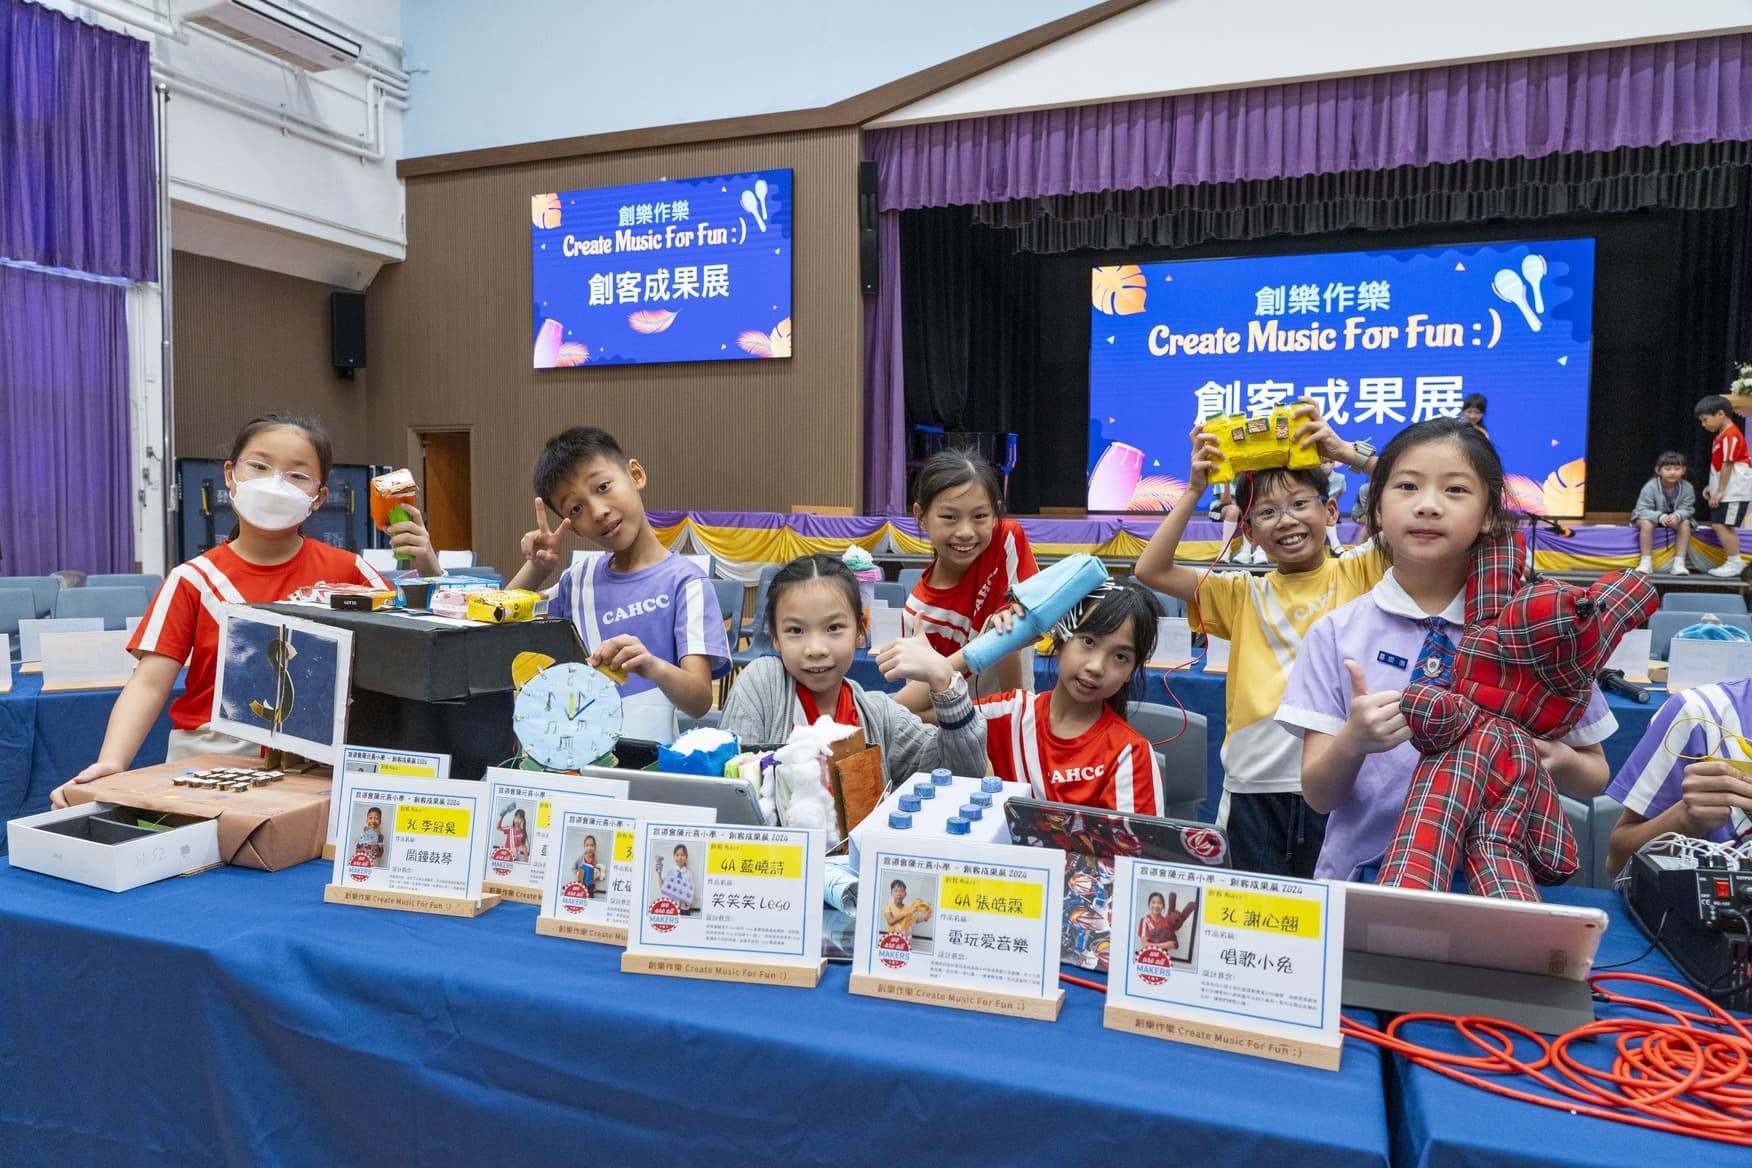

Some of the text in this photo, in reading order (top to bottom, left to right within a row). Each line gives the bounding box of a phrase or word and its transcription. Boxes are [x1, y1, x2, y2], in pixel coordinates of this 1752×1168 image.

[618, 200, 690, 226] 創樂作樂
[563, 235, 611, 256] Create
[615, 229, 662, 252] Music
[665, 225, 694, 248] For
[697, 223, 726, 245] Fun
[588, 264, 730, 306] 創客成果展
[1255, 281, 1391, 316] 創樂作樂
[1148, 325, 1240, 357] Create
[1247, 320, 1336, 352] Music
[1343, 316, 1398, 350] For
[1406, 314, 1463, 347] Fun
[602, 594, 670, 625] CAHCC
[1048, 764, 1105, 784] AHCC
[721, 858, 736, 872] 4A
[954, 893, 971, 908] 4A
[1282, 885, 1303, 894] 2024
[373, 896, 394, 904] Create
[396, 898, 415, 906] Music
[711, 892, 791, 912] 笑笑笑 Lego
[1220, 907, 1299, 933] 3C 謝心翹
[589, 930, 612, 938] Create
[948, 929, 1029, 953] 電玩愛音樂
[684, 964, 712, 974] Create
[716, 967, 740, 977] Music
[742, 969, 756, 978] For
[760, 971, 776, 980] Fun
[1136, 964, 1171, 976] MAKERS
[1220, 948, 1294, 974] 唱歌小兔
[916, 990, 946, 1000] Create
[948, 994, 974, 1005] Music
[977, 998, 992, 1006] For
[995, 999, 1013, 1009] Fun
[1178, 1026, 1211, 1040] Create
[1214, 1033, 1244, 1047] Music
[1247, 1039, 1265, 1050] For
[1268, 1043, 1289, 1055] Fun
